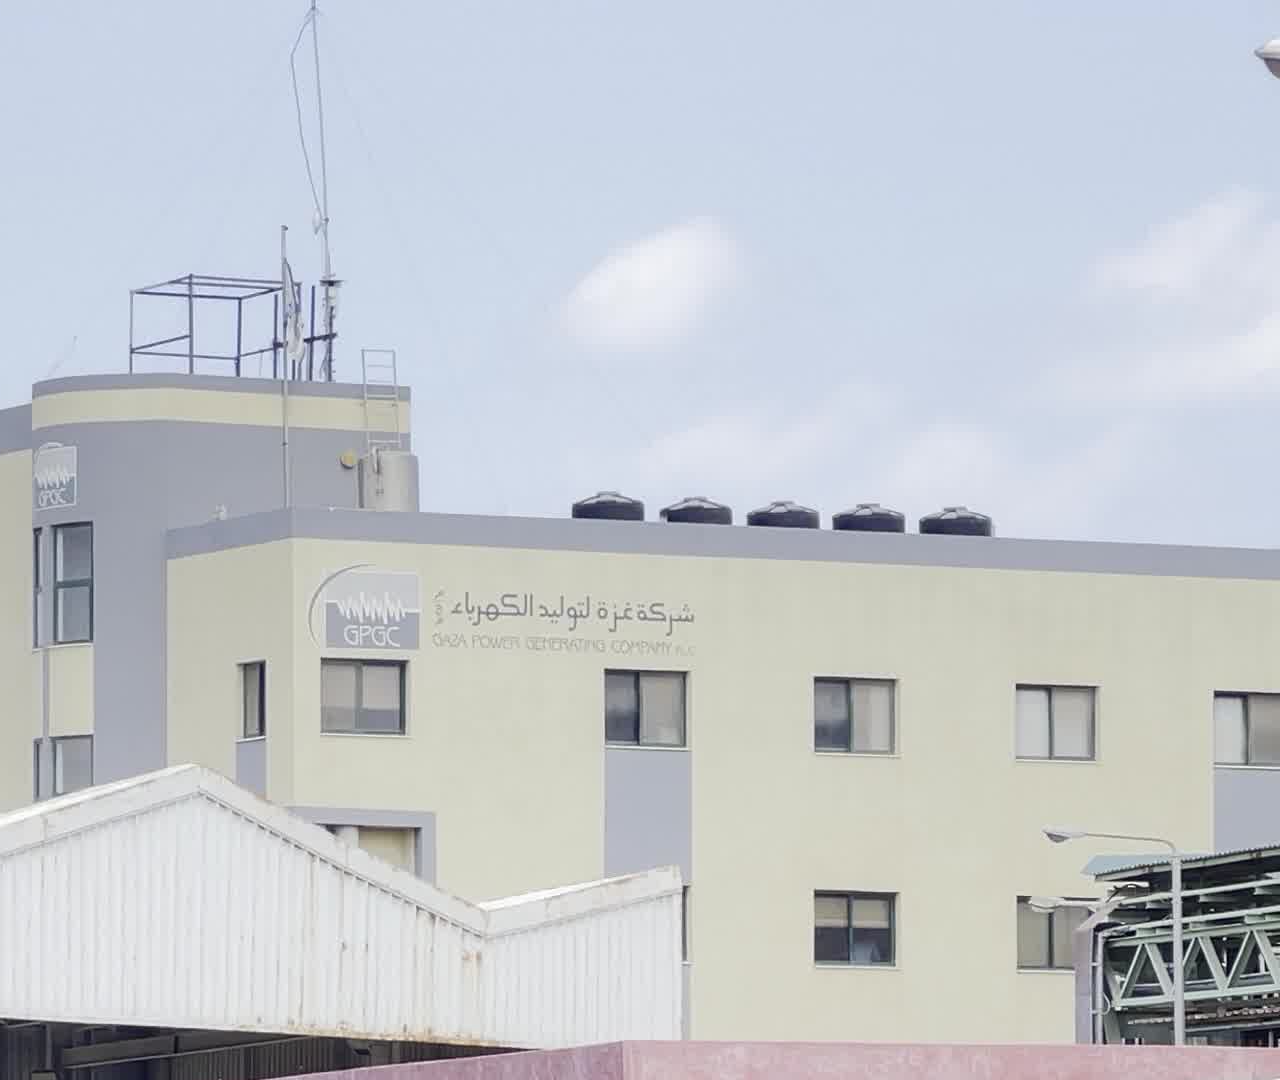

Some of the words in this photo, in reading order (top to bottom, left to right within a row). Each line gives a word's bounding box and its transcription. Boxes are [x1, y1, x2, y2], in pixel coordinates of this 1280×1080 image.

[450, 591, 534, 626] الكهرباء
[538, 594, 591, 632] لتوليد
[597, 602, 634, 633] غزة
[636, 603, 695, 637] شركة
[343, 624, 401, 648] GPGC
[432, 632, 468, 648] GAZA
[471, 634, 521, 650] POWER
